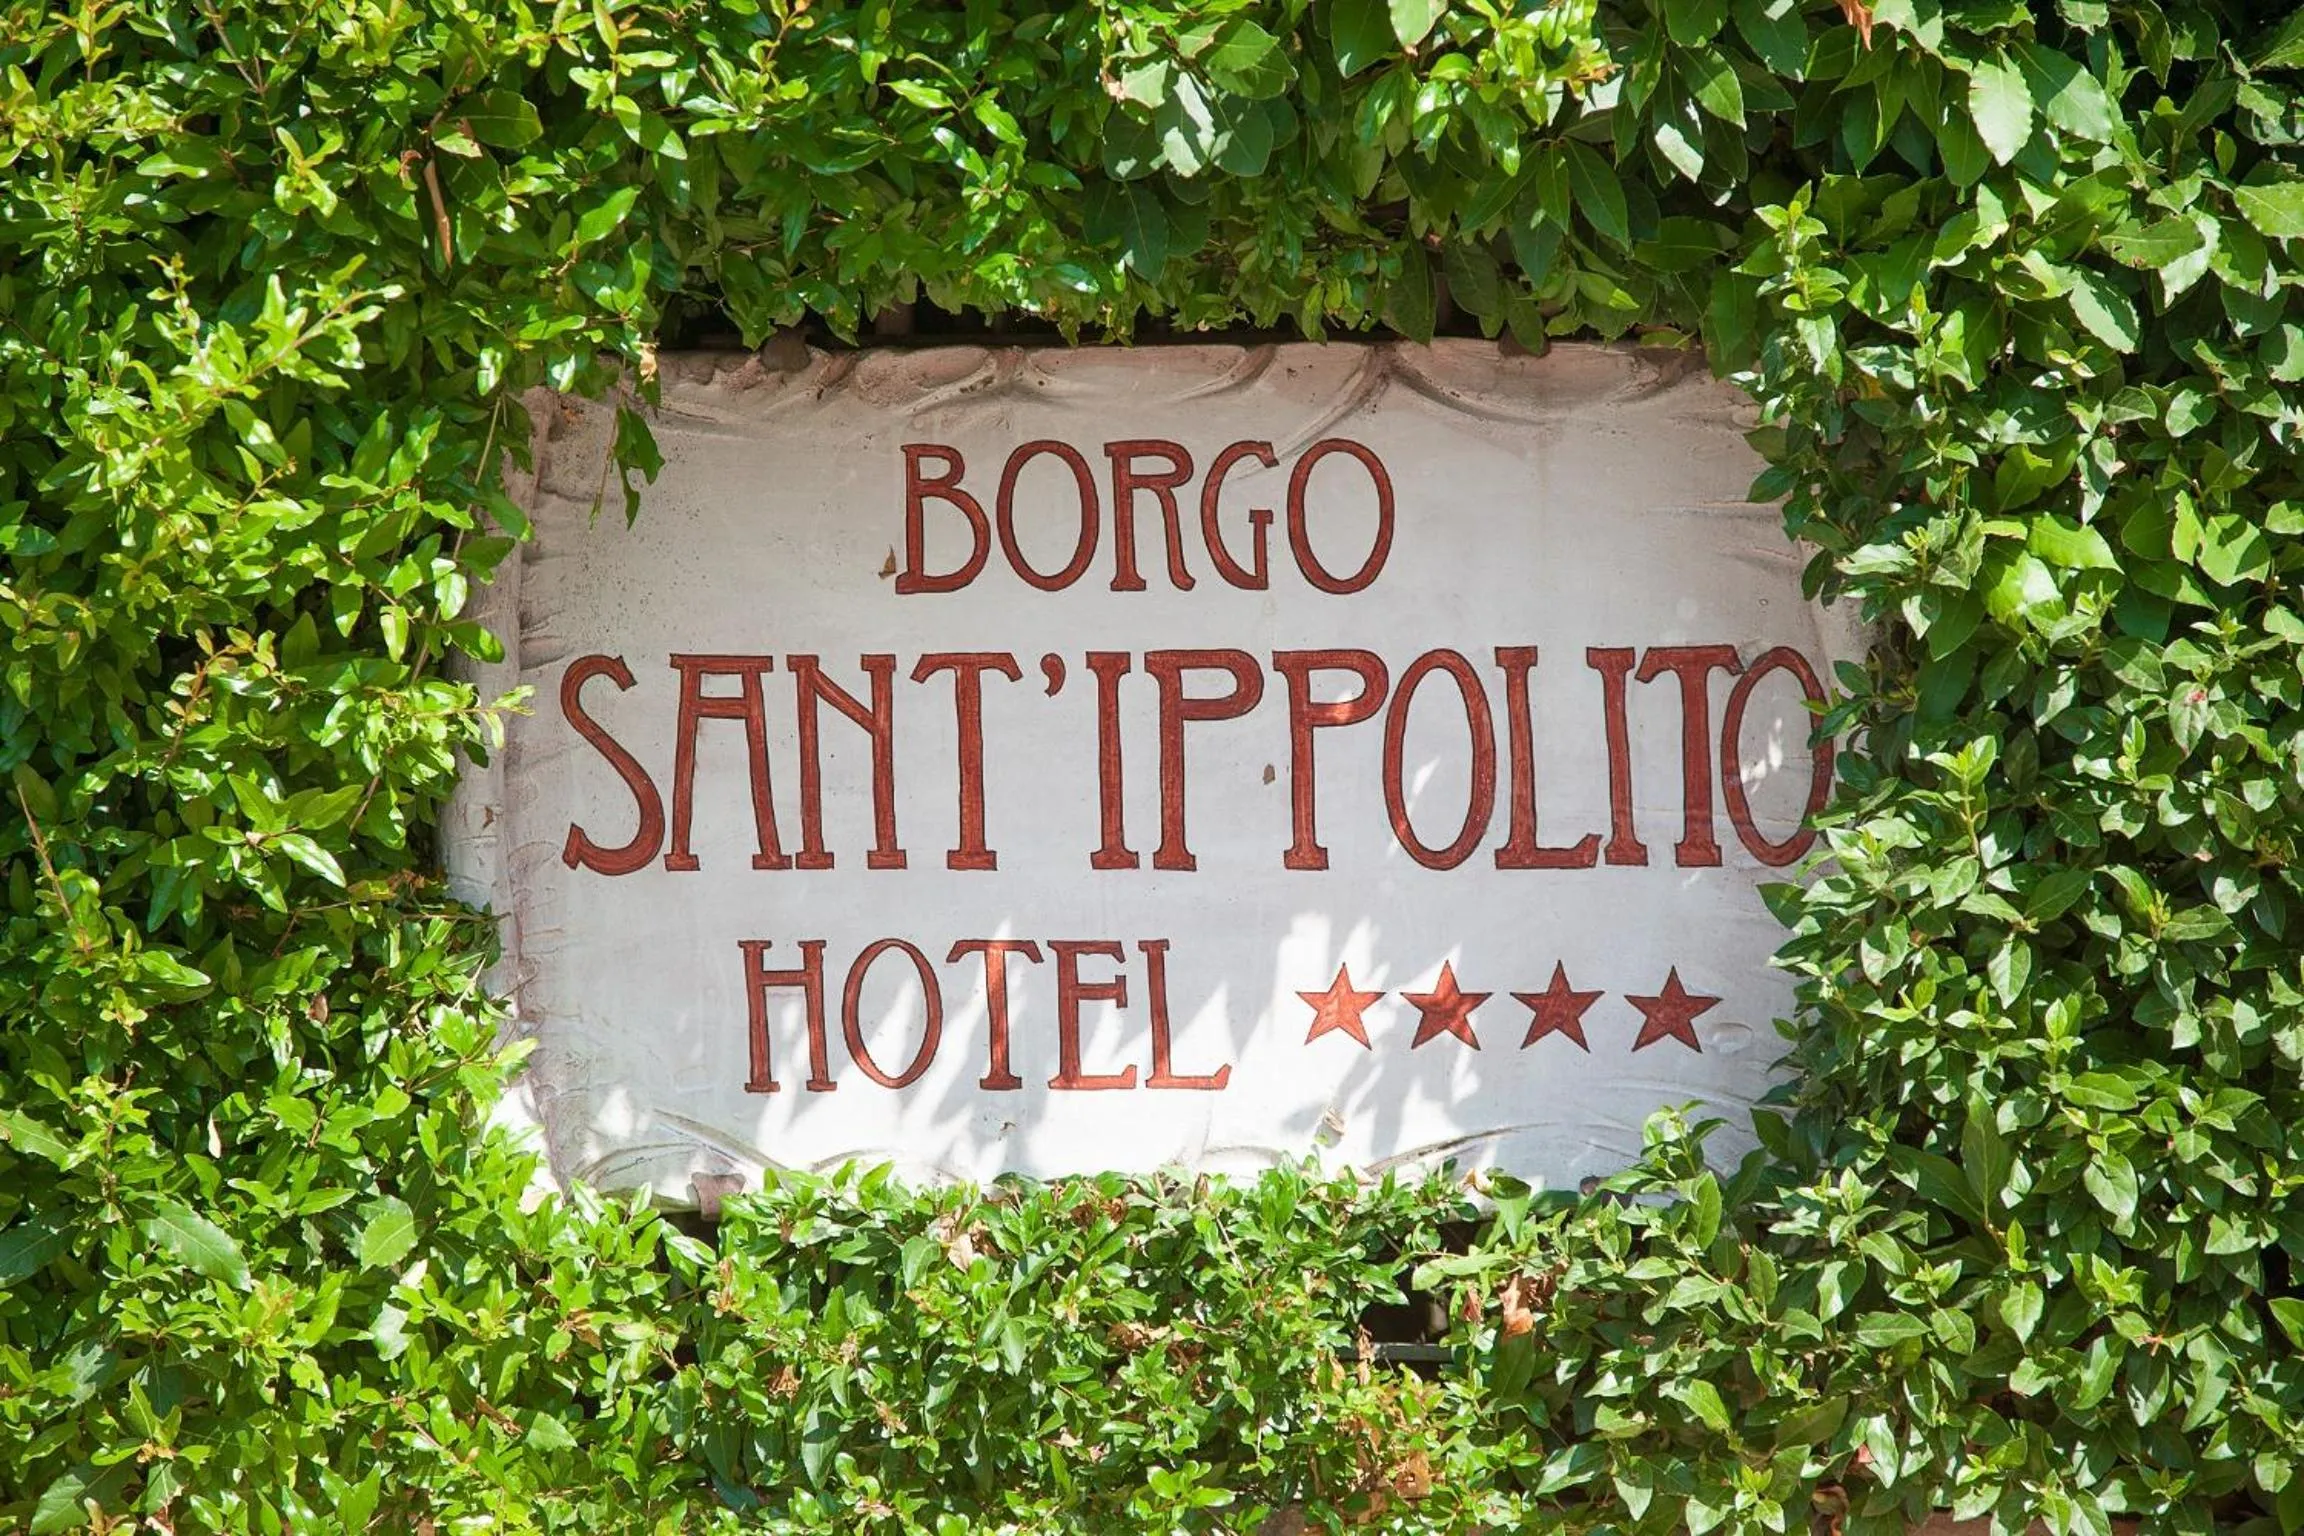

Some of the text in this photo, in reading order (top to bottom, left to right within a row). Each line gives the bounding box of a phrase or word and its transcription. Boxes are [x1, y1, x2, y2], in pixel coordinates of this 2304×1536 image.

[895, 436, 1397, 596] BORGO
[561, 643, 1835, 876] SANT'IPPOLITO
[738, 937, 1232, 1095] HOTEL
